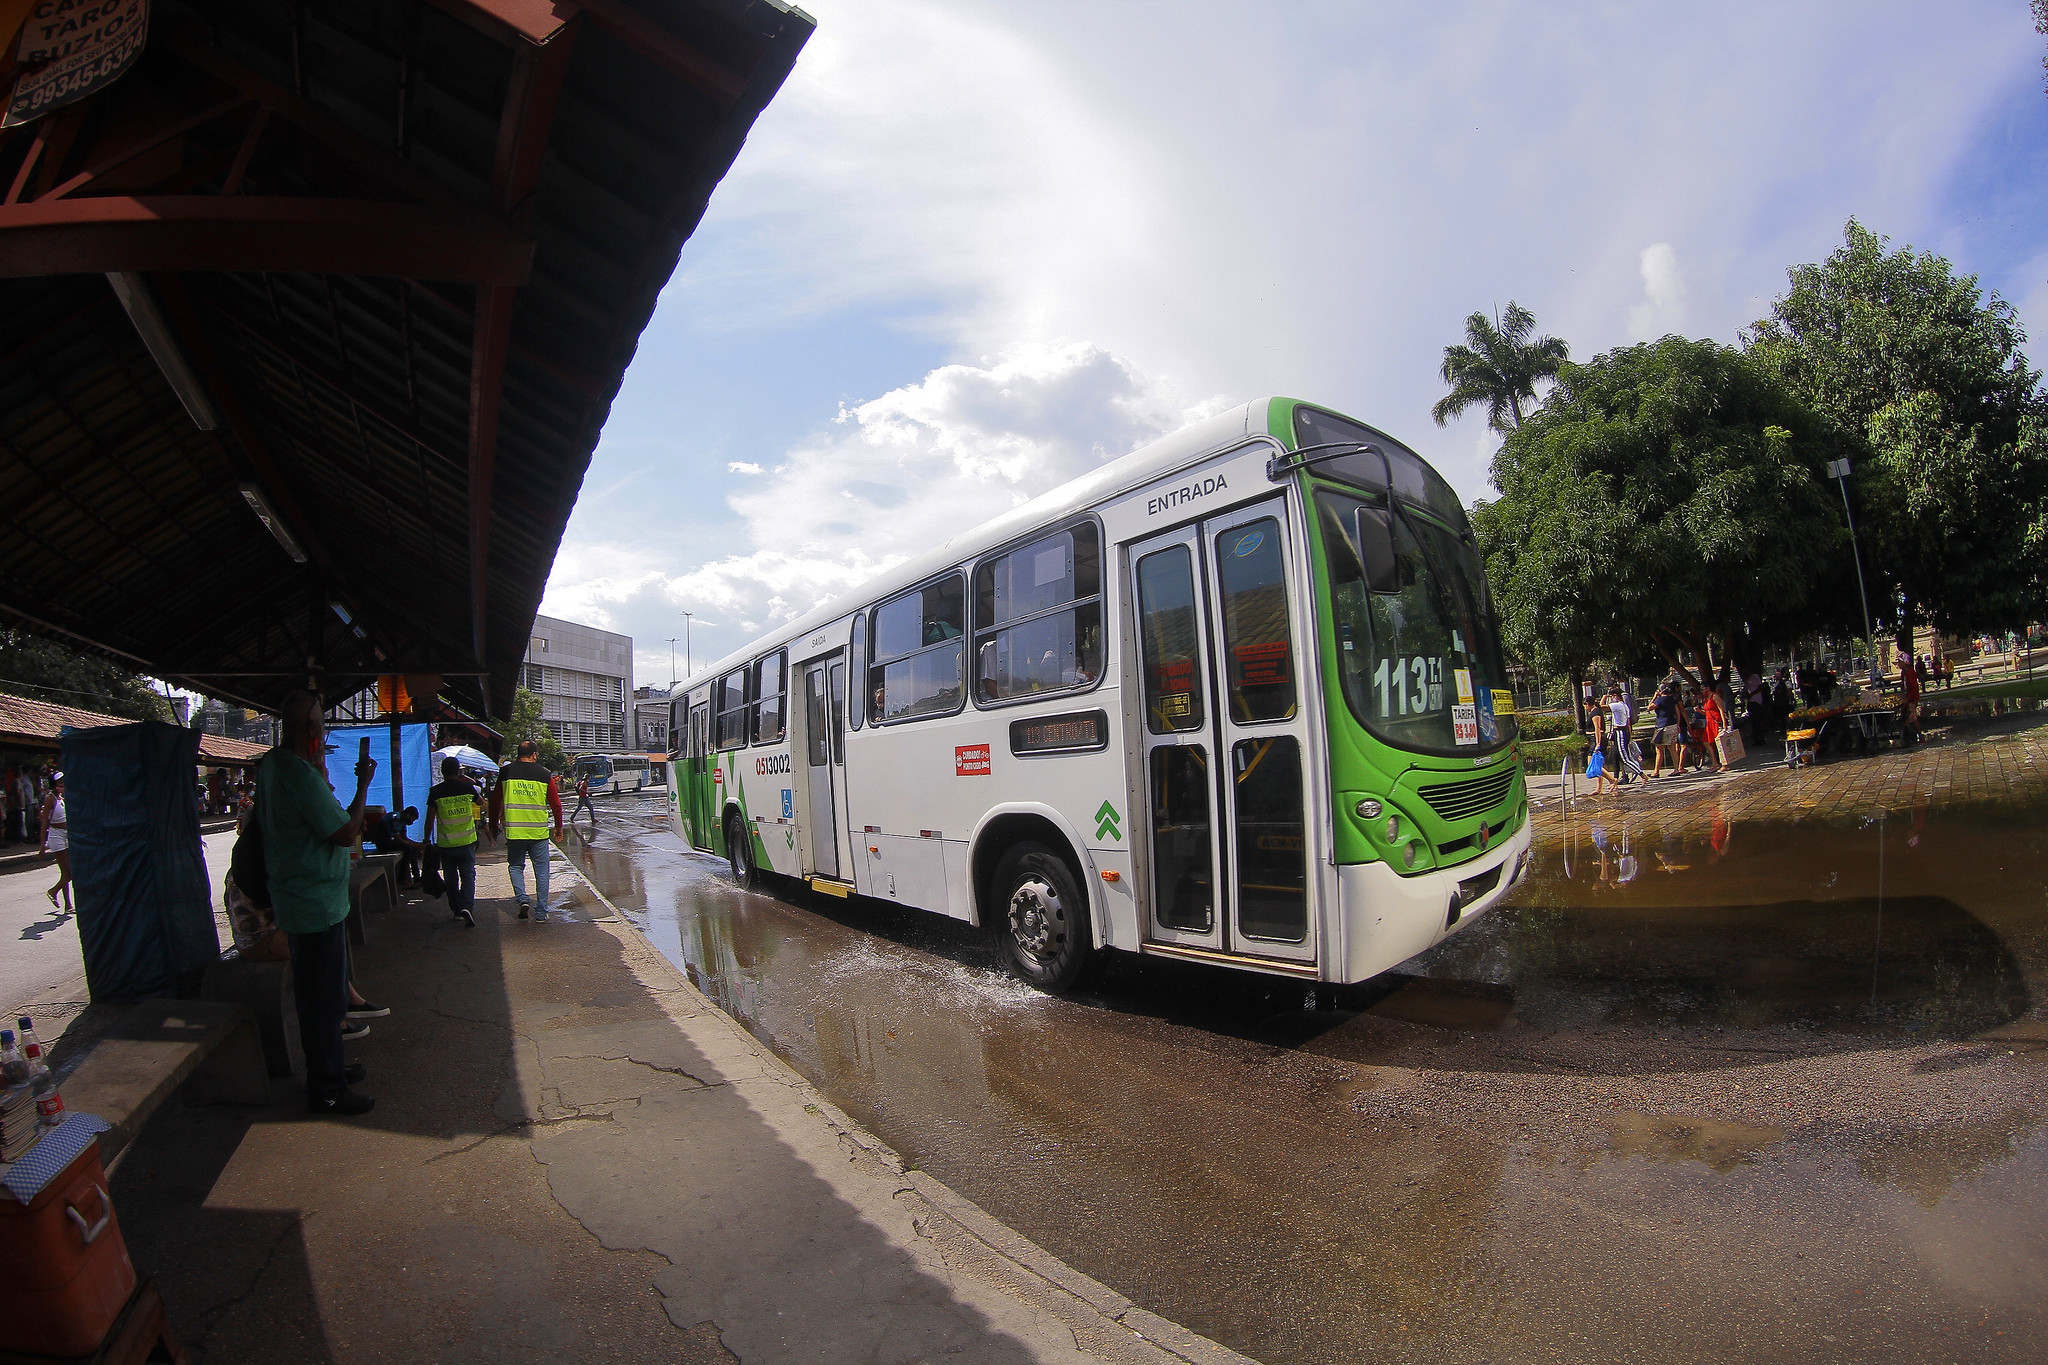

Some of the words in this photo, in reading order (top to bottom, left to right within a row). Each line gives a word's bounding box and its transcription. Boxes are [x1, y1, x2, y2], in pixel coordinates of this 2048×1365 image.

[31, 25, 142, 110] 99345-6324
[67, 56, 83, 70] FOR
[1148, 474, 1228, 516] ENTRADA
[1428, 657, 1442, 682] T.1
[1374, 656, 1429, 718] 113
[1454, 709, 1475, 720] TARIFA
[1455, 724, 1464, 740] R$
[755, 754, 791, 776] 0513002
[513, 789, 537, 798] DIRETOR
[447, 808, 468, 816] IMMU
